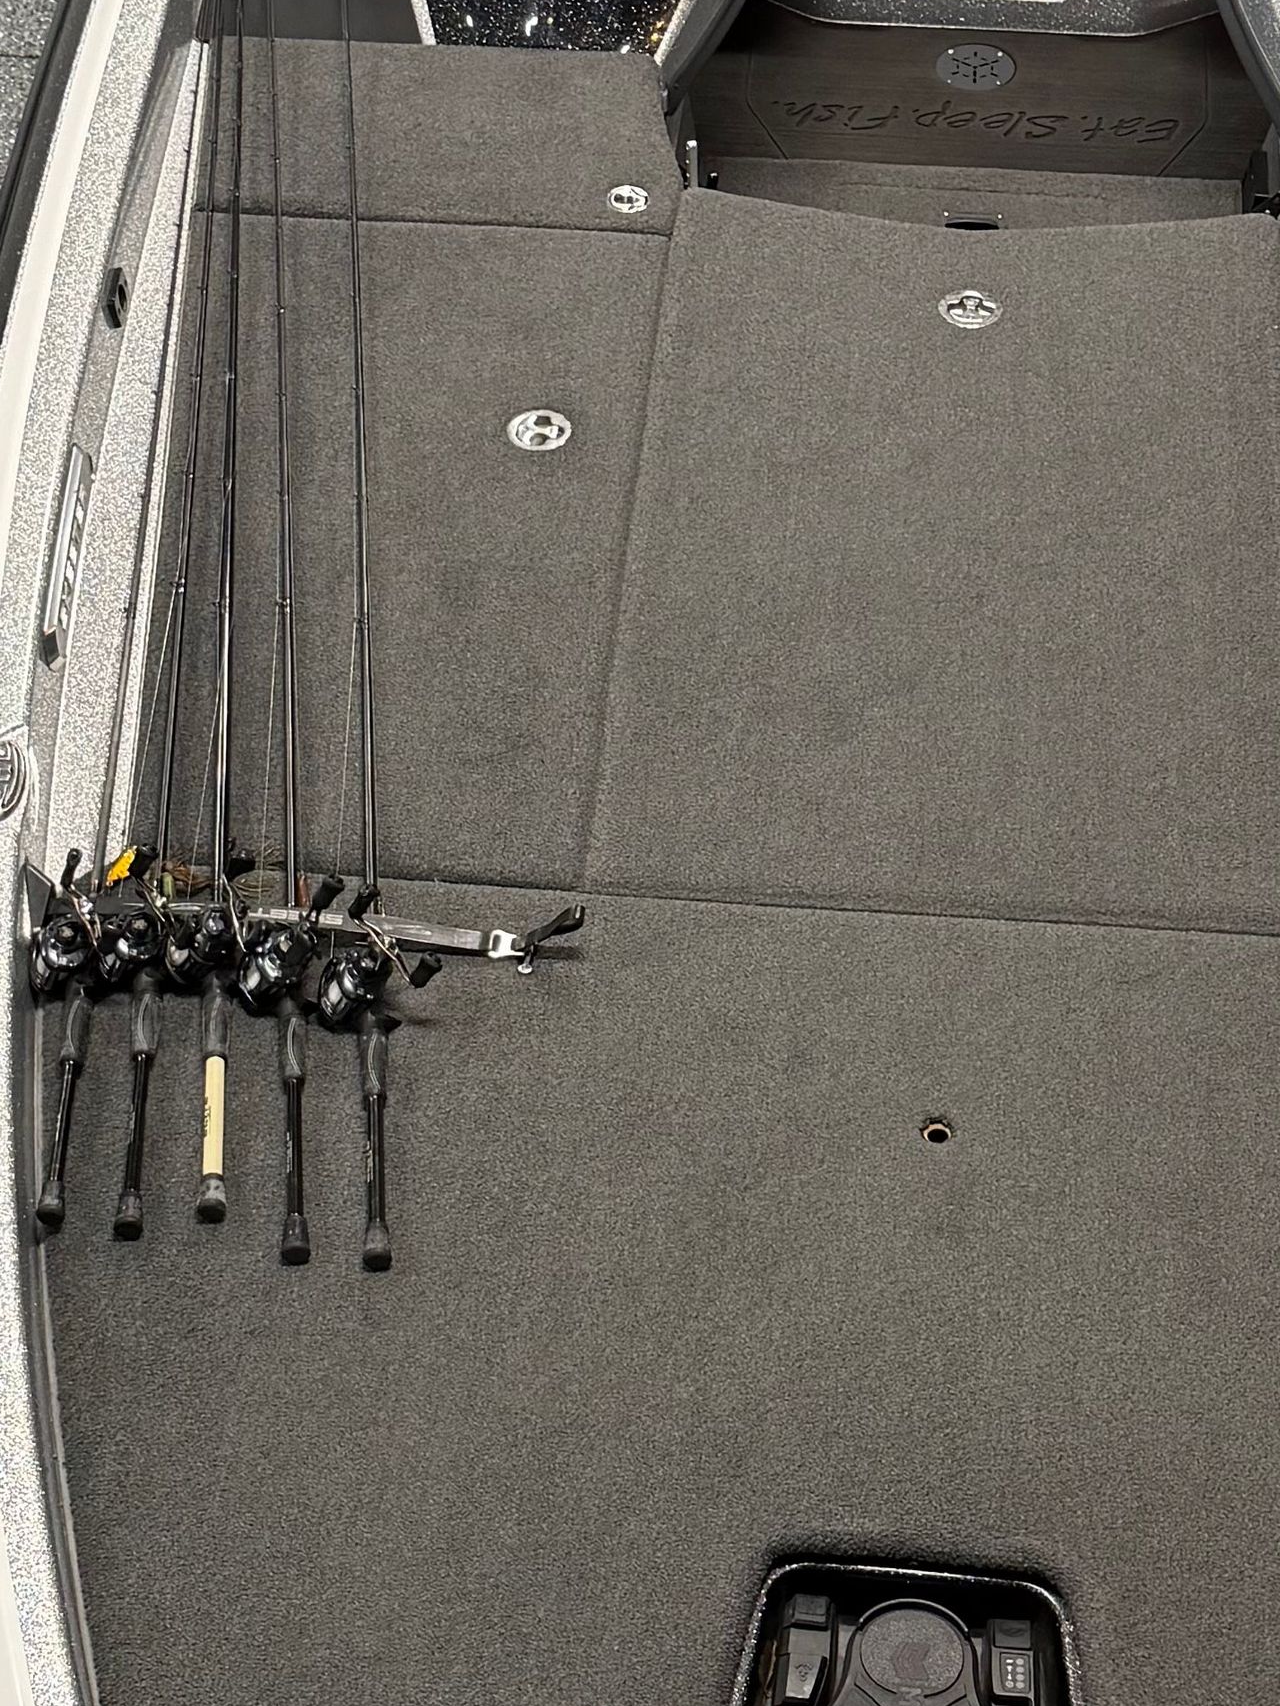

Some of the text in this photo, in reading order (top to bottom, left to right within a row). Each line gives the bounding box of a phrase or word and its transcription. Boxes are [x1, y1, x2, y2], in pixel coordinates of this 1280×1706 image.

[771, 100, 1180, 144] Eat. Sleep. Fish.
